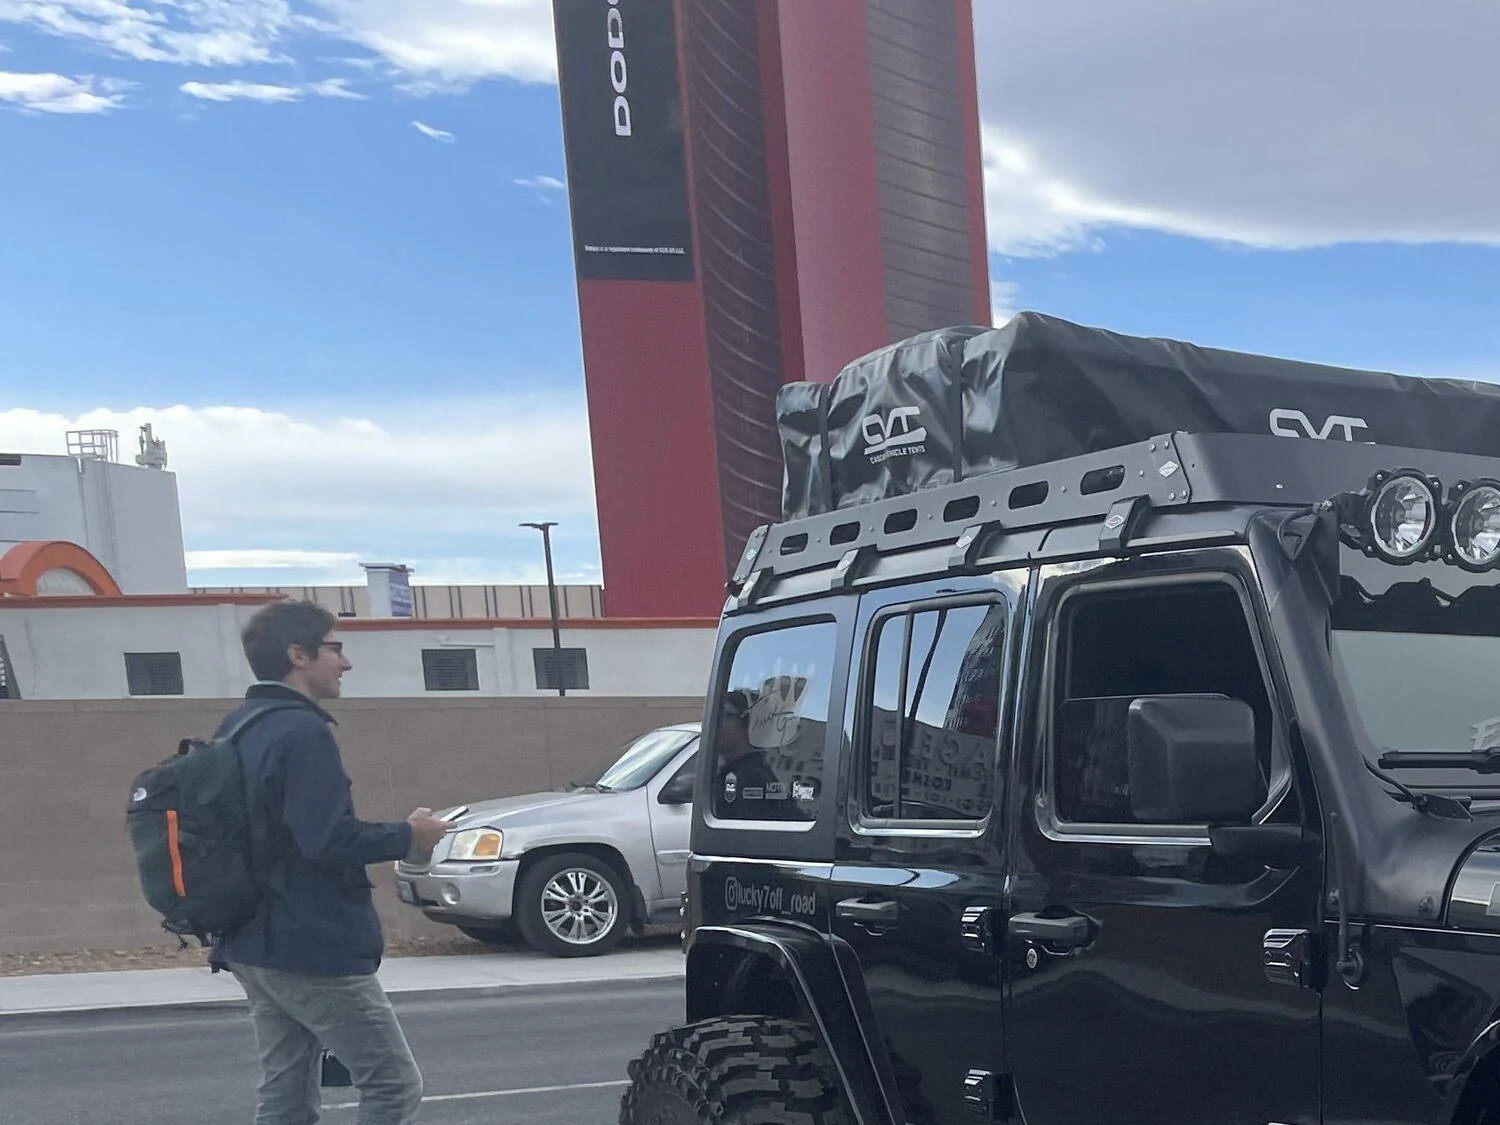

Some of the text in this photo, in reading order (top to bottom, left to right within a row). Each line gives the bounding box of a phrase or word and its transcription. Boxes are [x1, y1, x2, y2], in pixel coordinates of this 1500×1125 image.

[607, 0, 632, 136] DOD
[862, 406, 920, 445] CVT
[1269, 408, 1368, 441] CVT
